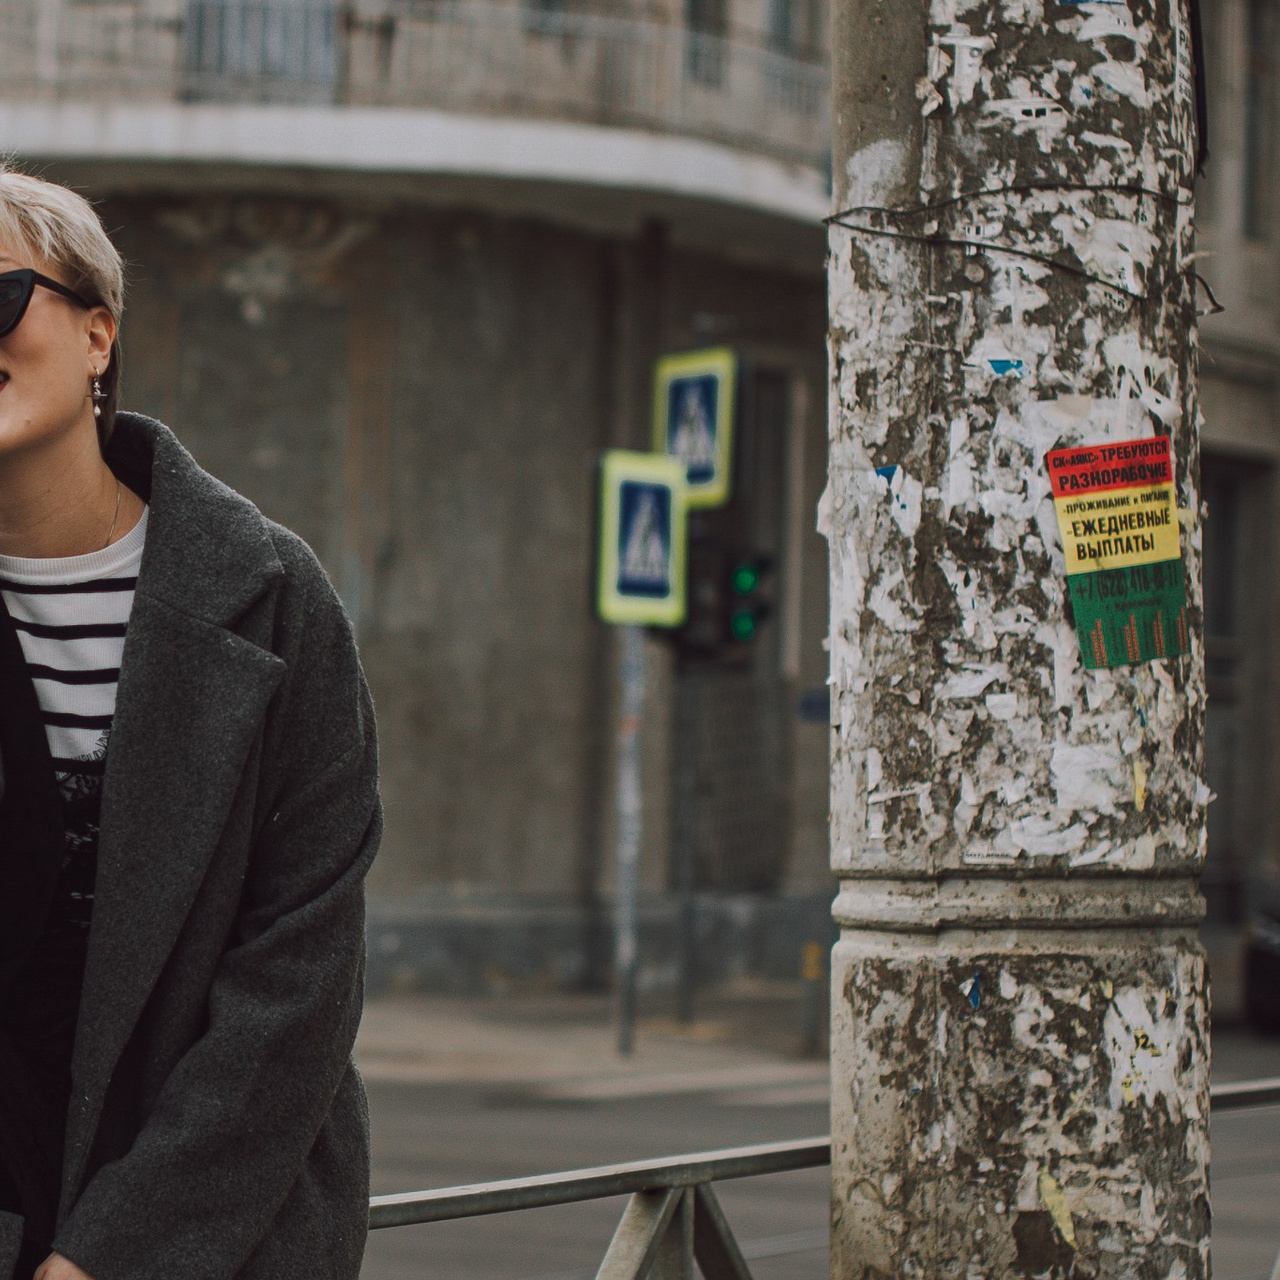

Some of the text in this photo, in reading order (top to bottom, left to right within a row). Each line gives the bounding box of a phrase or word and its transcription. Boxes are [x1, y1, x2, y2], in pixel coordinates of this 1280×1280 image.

[1100, 440, 1167, 462] ТРЕБУЮТСЯ
[1058, 461, 1168, 491] РАЗНОРАБОЧИЕ
[1076, 533, 1155, 560] ВЫПЛАТЫ
[1075, 572, 1093, 600] +7
